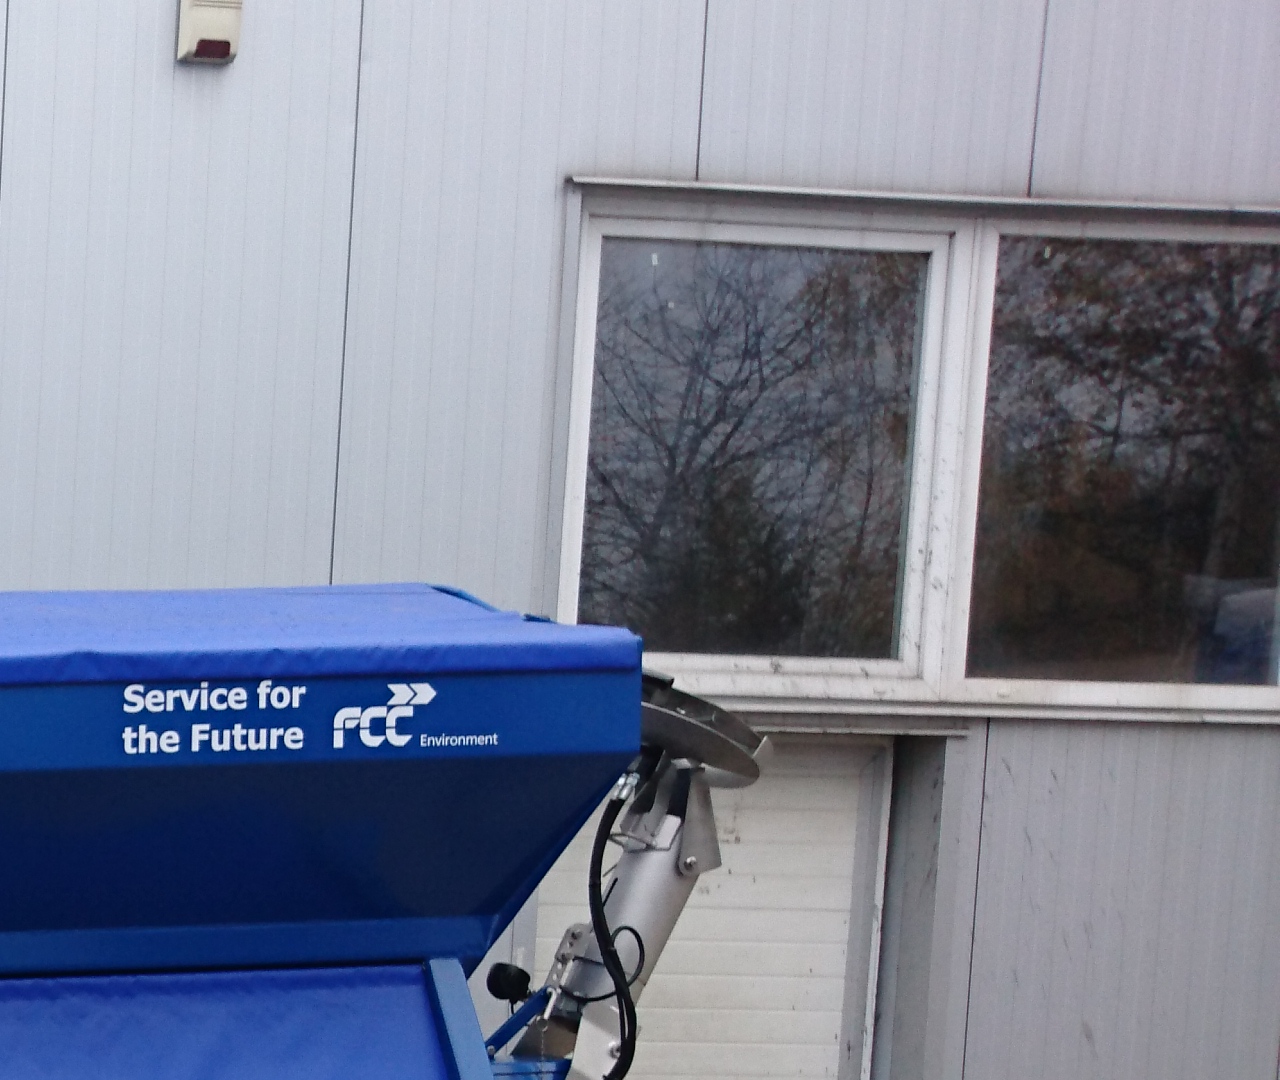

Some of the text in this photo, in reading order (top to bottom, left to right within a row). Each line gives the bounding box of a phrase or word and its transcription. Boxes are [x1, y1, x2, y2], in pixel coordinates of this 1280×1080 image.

[122, 680, 306, 713] Service for
[122, 723, 304, 754] the Future
[333, 706, 414, 748] FCC
[419, 732, 499, 747] Environment
